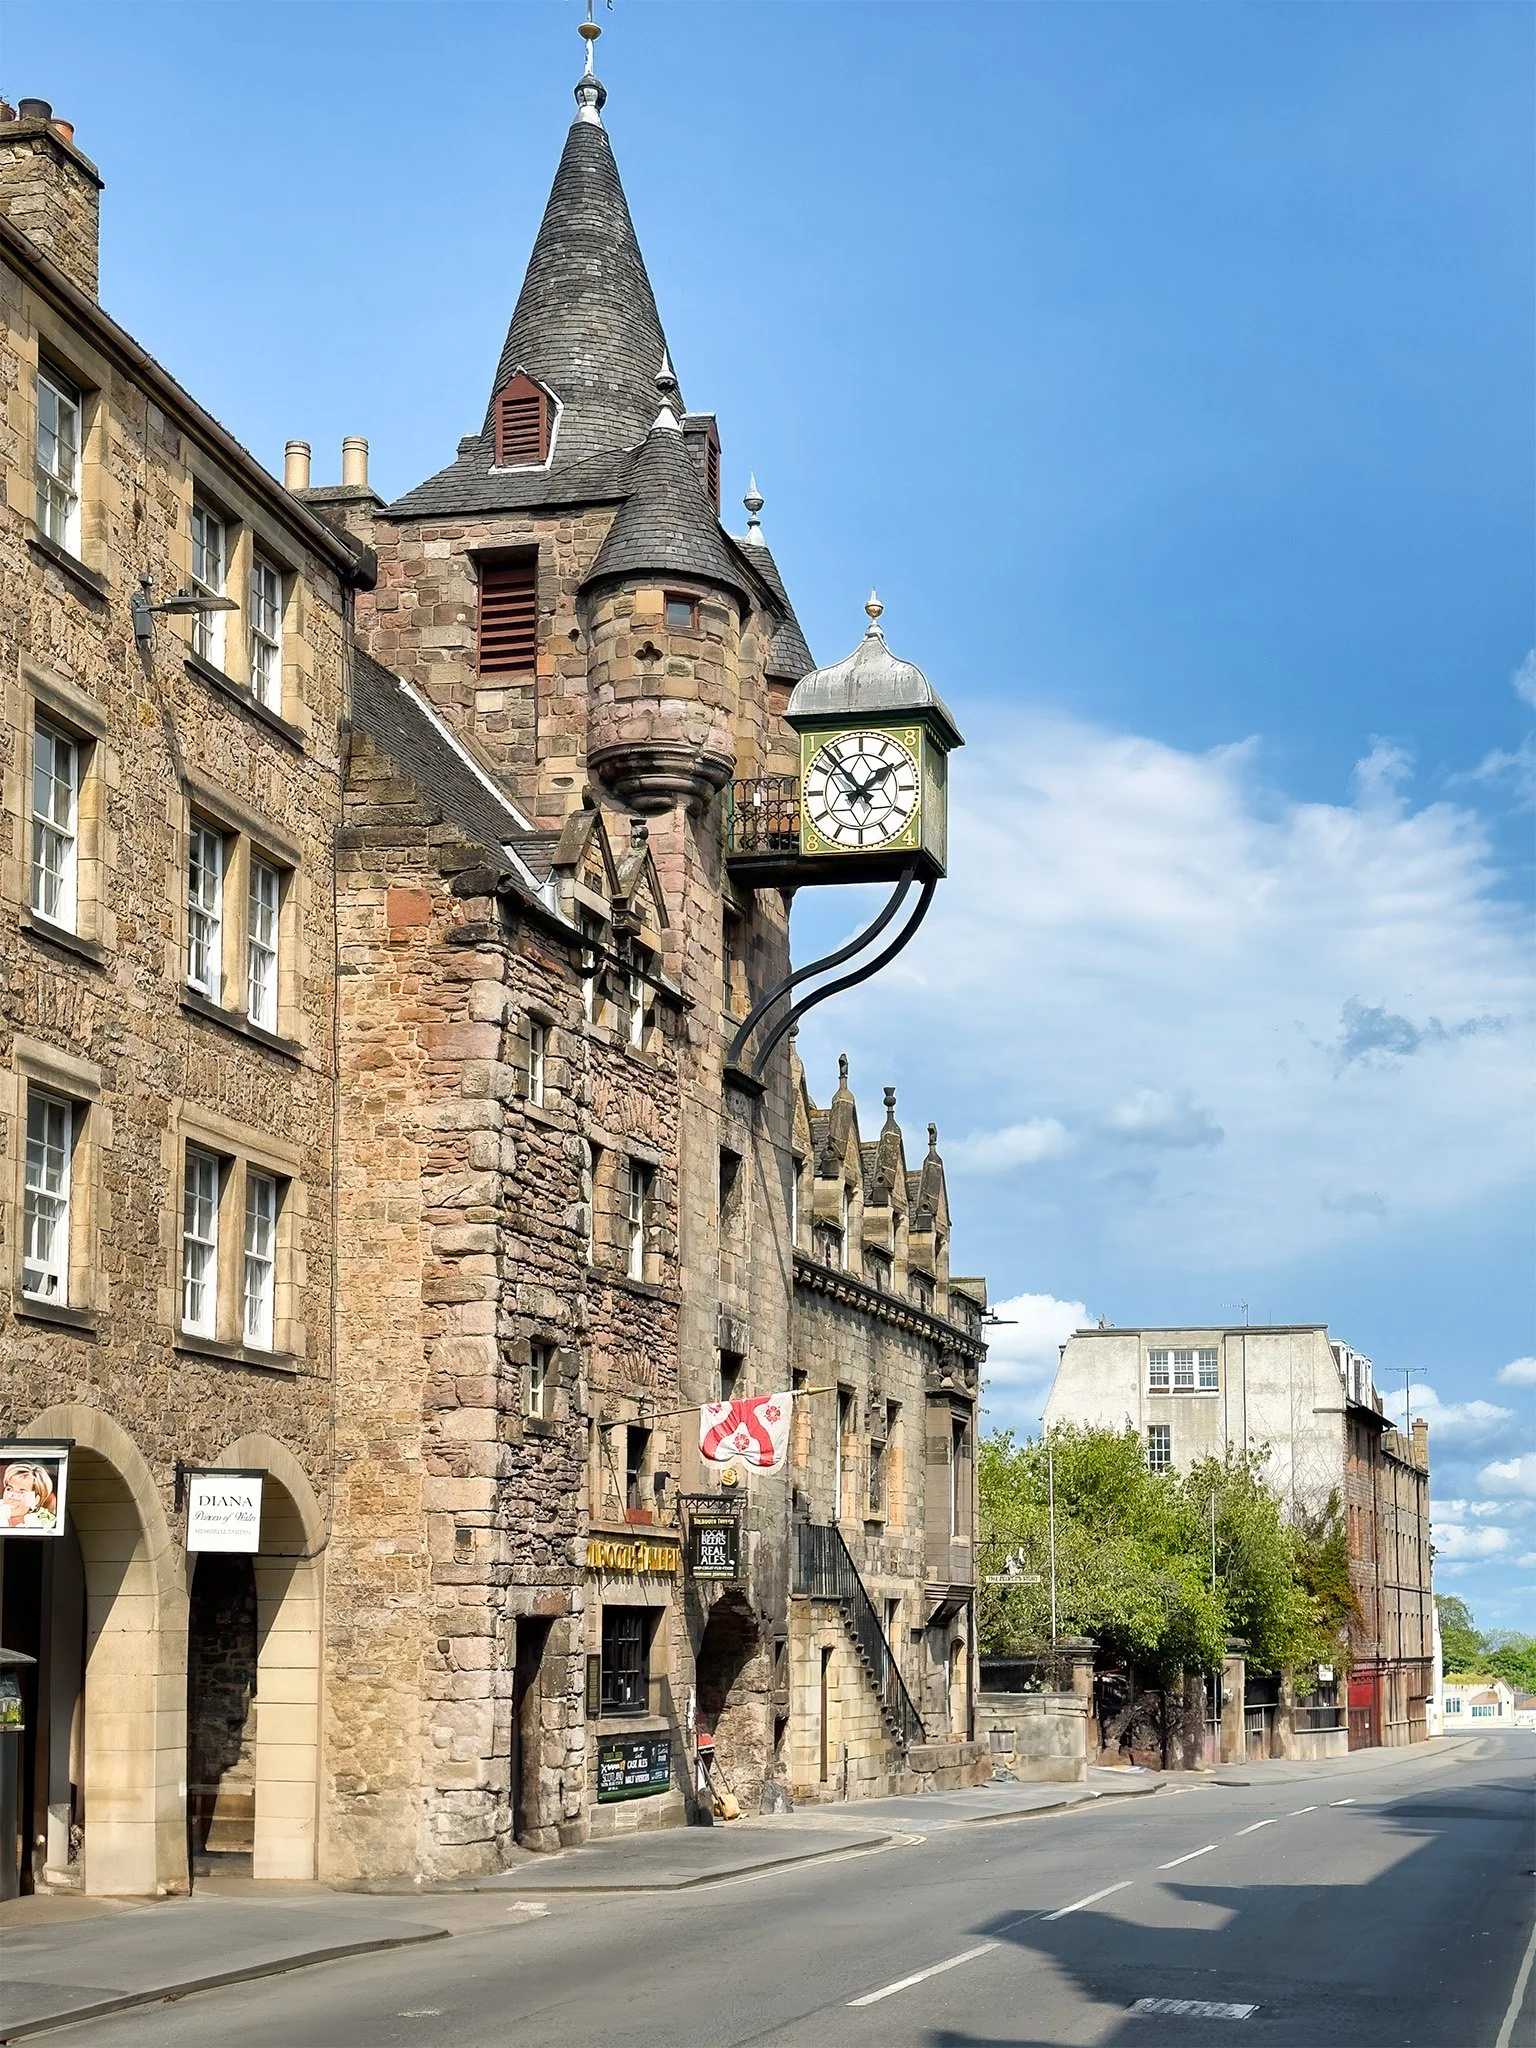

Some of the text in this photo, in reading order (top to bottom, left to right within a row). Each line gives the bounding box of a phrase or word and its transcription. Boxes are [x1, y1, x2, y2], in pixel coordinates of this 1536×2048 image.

[809, 730, 916, 753] 1 8
[806, 829, 915, 851] 8 4
[199, 1495, 253, 1507] DIANA
[701, 1529, 727, 1537] LOCAL
[701, 1536, 727, 1545] BEERS
[701, 1546, 727, 1556] REAL
[700, 1555, 727, 1565] ALES
